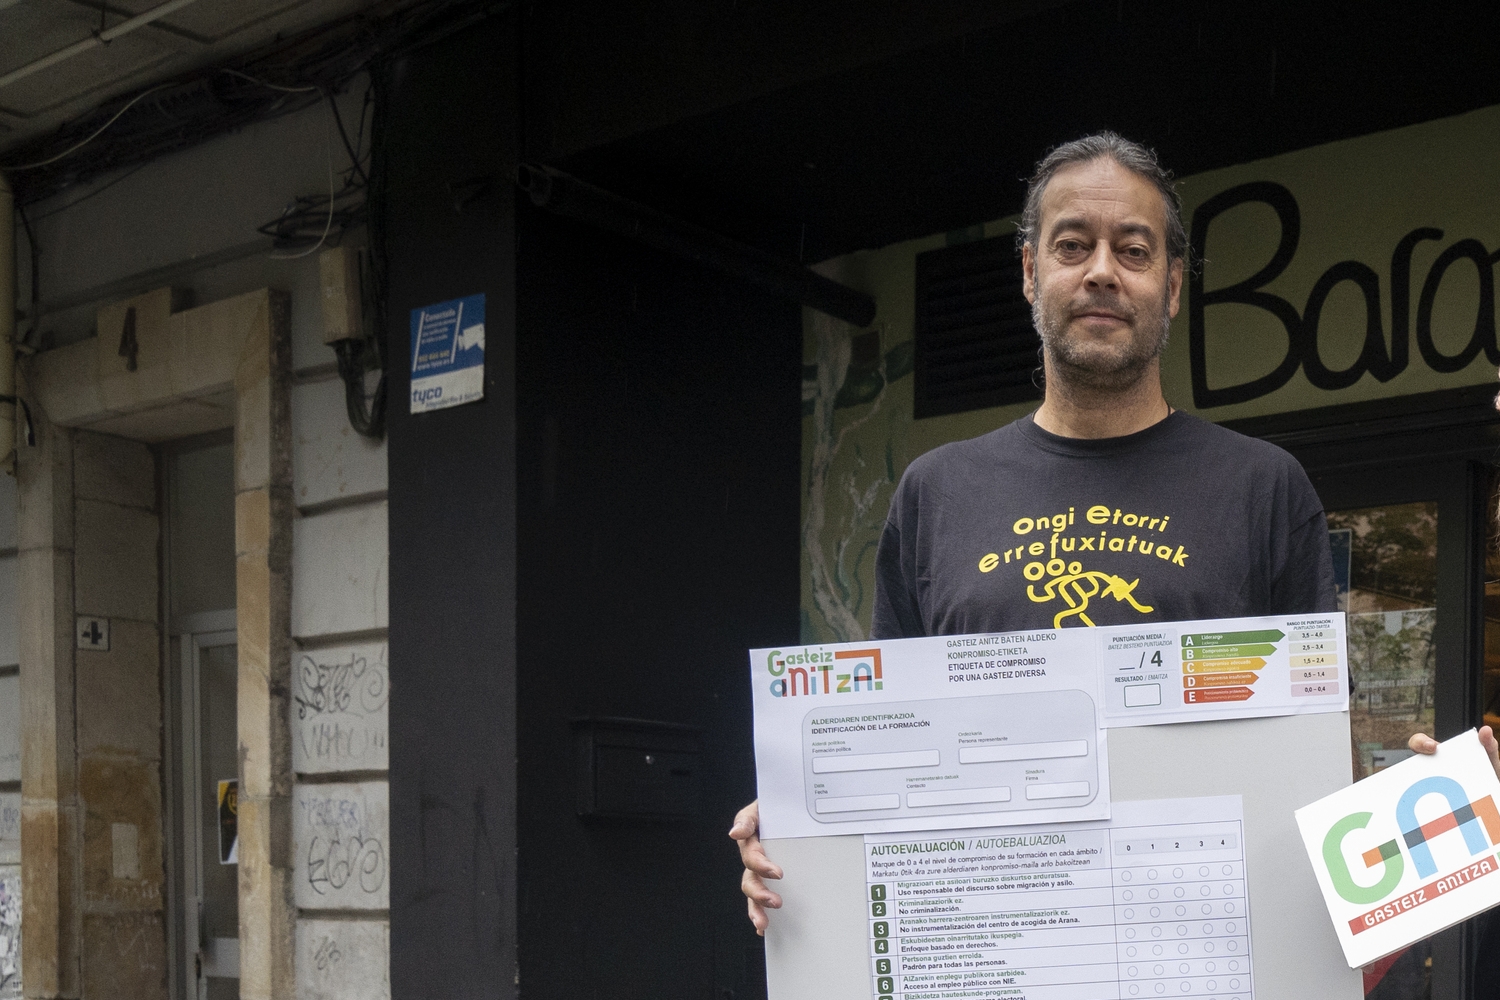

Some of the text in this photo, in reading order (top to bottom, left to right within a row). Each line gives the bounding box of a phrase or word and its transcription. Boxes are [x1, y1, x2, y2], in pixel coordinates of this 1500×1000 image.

[119, 306, 140, 373] 4
[412, 386, 443, 404] tyco
[82, 620, 103, 645] 4
[1112, 634, 1145, 643] PUNTUACIÓN
[947, 633, 1057, 648] GASTEIZ ANITZ BATEN ALDEKO
[1185, 636, 1194, 646] A
[948, 647, 1028, 660] KONPROMISO-ETIKETA
[1150, 651, 1163, 667] 4
[1186, 649, 1194, 659] B
[767, 647, 833, 677] Gasteiz
[948, 657, 1046, 671] ETIQUETA DE COMPROMISO
[1186, 662, 1195, 673] C
[949, 669, 1046, 683] POR UNA GASTEIZ DIVERSA
[1115, 675, 1144, 683] RESULTADO
[1148, 673, 1168, 681] EMAITZA
[1187, 677, 1196, 687] D
[1189, 691, 1196, 702] E
[811, 712, 915, 725] ALDERDIAREN IDENTIFIKAZIOA
[811, 724, 866, 735] IDENTIFICACIÓN
[888, 720, 931, 730] FORMACIÓN
[871, 839, 965, 856] AUTOEVALUACIÓN
[975, 834, 1067, 850] AUTOEBALUAZIOA
[875, 887, 881, 898] 1
[913, 886, 953, 896] responsable
[966, 884, 995, 892] discurso
[1017, 880, 1050, 889] migración
[876, 906, 882, 914] 2
[910, 906, 961, 914] criminalización.
[1364, 890, 1427, 927] GASTEIZ
[877, 925, 885, 935] 3
[878, 942, 885, 952] 4
[901, 945, 929, 954] Enfoque
[967, 941, 999, 949] derechos.
[880, 962, 887, 972] 5
[902, 963, 927, 971] Padrón
[944, 961, 962, 969] todas
[882, 980, 889, 990] 6
[904, 982, 929, 990] Acceso
[938, 981, 962, 989] empleo
[962, 980, 988, 988] público
[1002, 977, 1017, 985] NIE.
